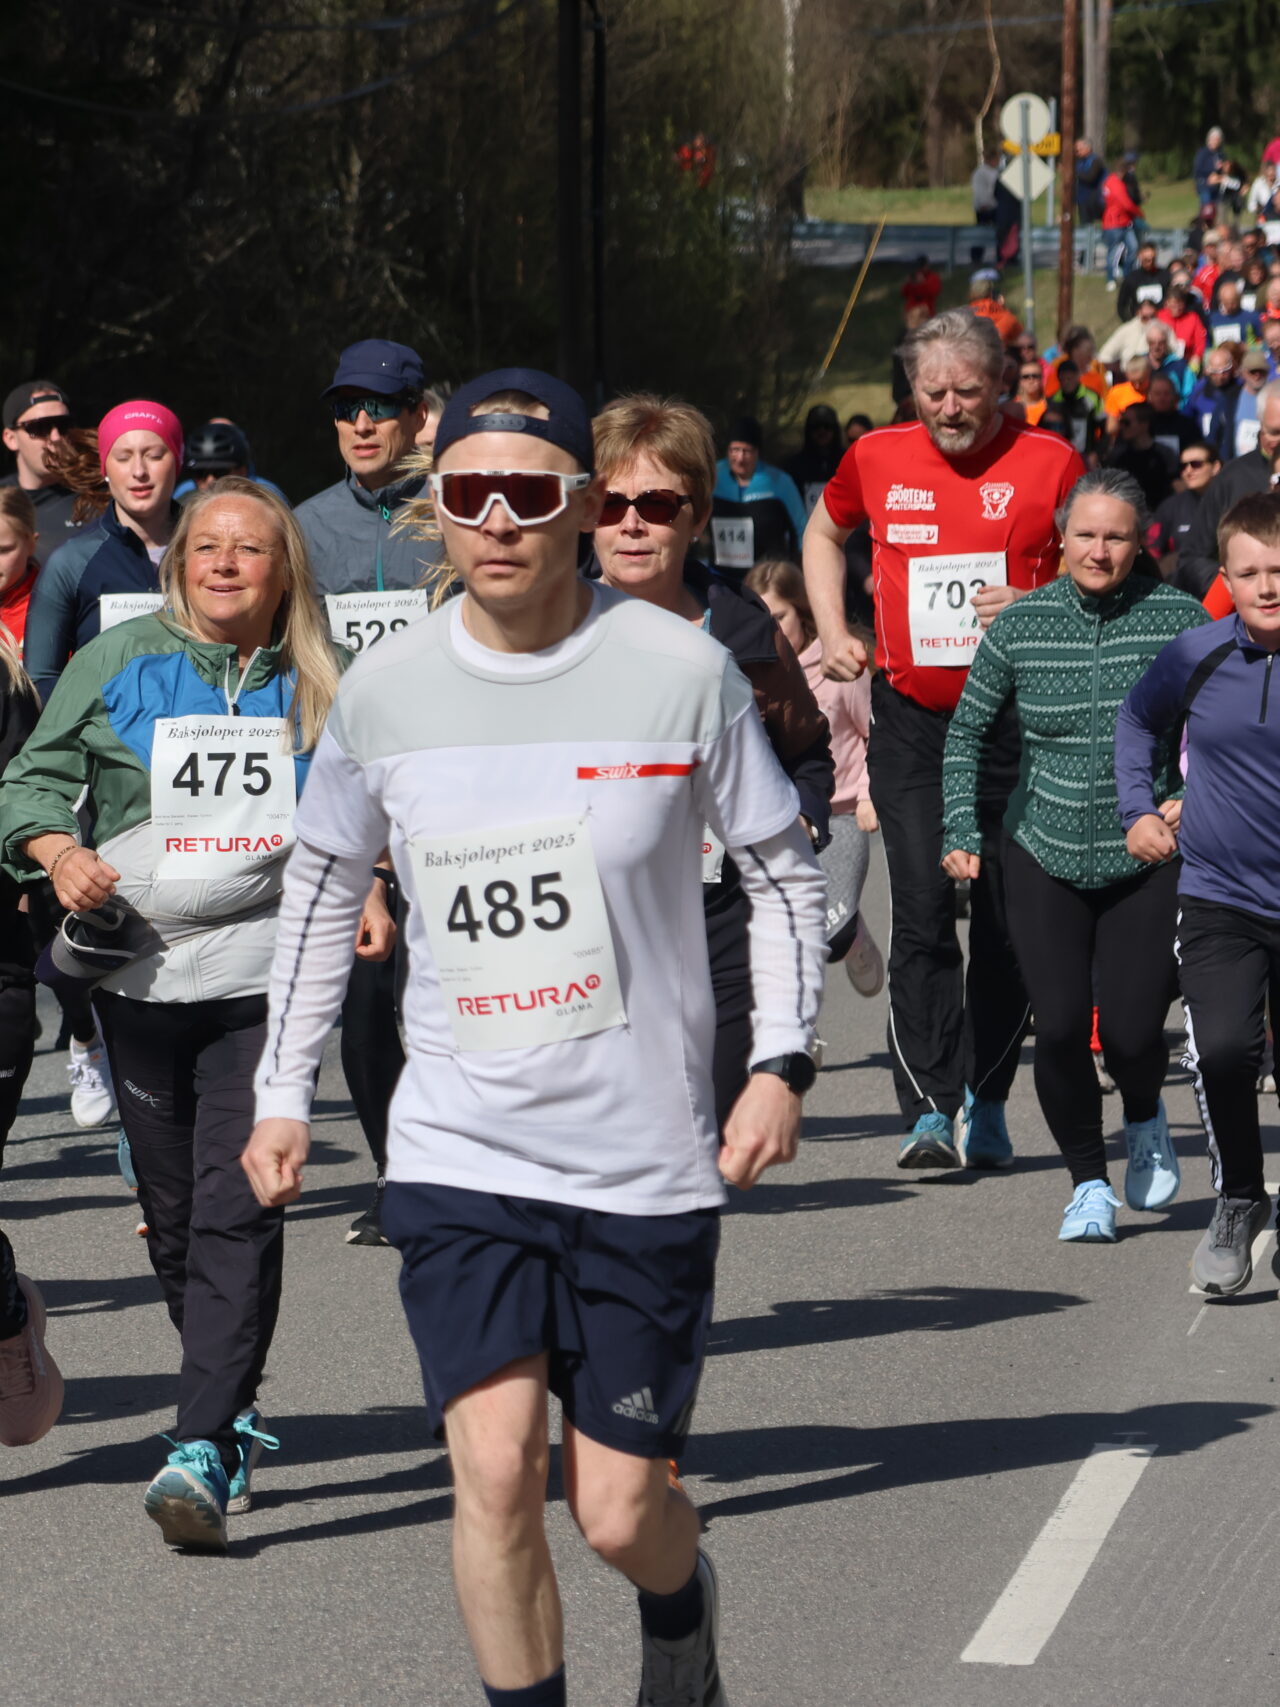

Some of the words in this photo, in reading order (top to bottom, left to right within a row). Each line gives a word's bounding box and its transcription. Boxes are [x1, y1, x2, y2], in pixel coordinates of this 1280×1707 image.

[393, 598, 419, 608] 2025
[248, 727, 281, 738] 2025
[172, 752, 272, 797] 475
[165, 836, 272, 853] RETURA
[531, 832, 577, 853] 2025
[446, 871, 572, 943] 485
[456, 981, 590, 1018] RETURA
[612, 1403, 659, 1425] adidas
